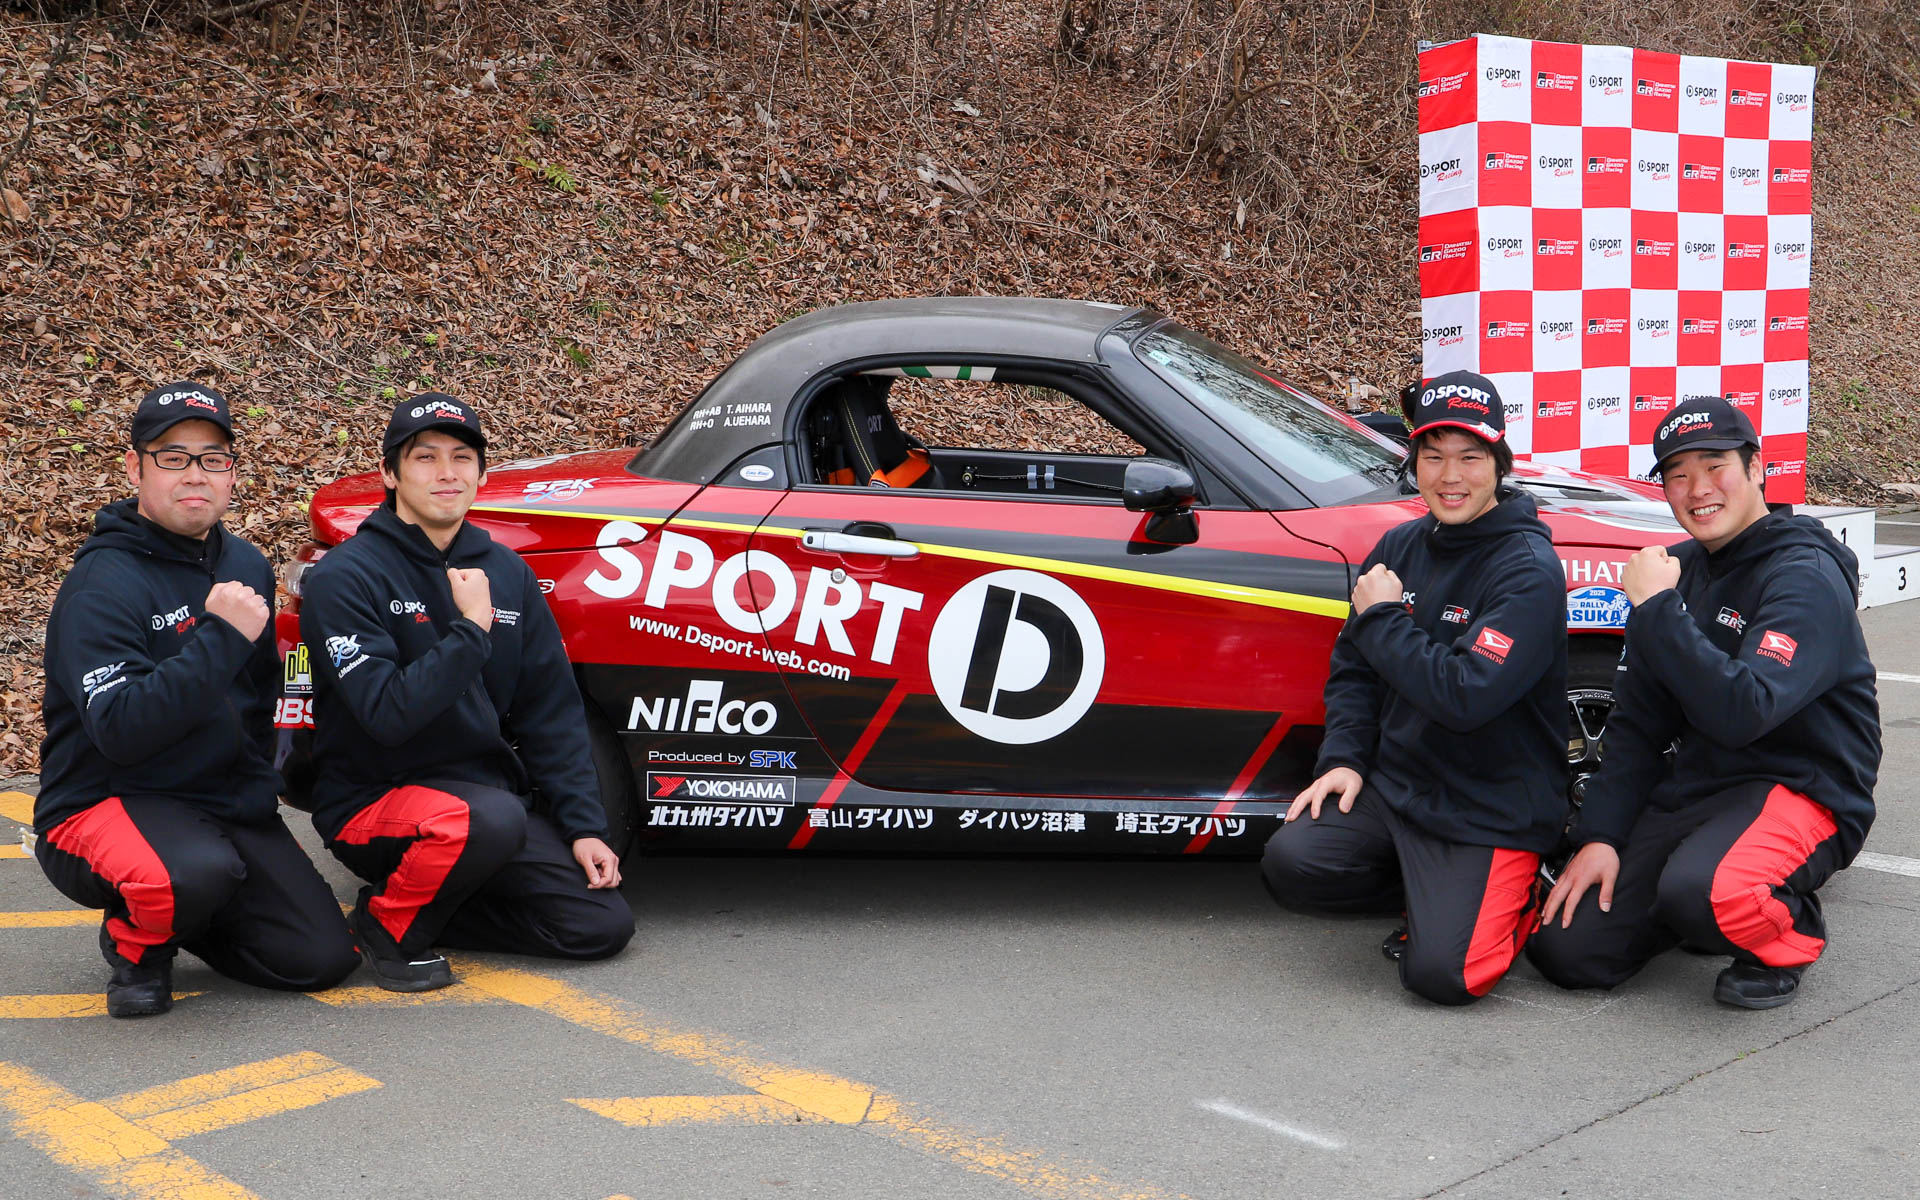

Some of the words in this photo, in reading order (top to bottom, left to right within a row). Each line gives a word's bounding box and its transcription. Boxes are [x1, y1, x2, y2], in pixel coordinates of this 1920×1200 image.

[1537, 79, 1554, 88] GR
[1419, 85, 1438, 96] GR
[1637, 86, 1653, 95] GR
[1730, 96, 1745, 104] GR
[1486, 159, 1503, 169] GR
[1588, 163, 1604, 172] GR
[1684, 170, 1699, 178] GR
[1774, 174, 1788, 182] GR
[1537, 245, 1554, 254] GR
[1636, 246, 1651, 255] GR
[1728, 249, 1743, 257] GR
[1421, 251, 1442, 262] GR
[1588, 325, 1604, 334] GR
[1683, 325, 1698, 333] GR
[1770, 322, 1785, 330] GR
[1488, 328, 1505, 337] GR
[174, 391, 214, 405] SPORT
[1436, 384, 1491, 404] SPORT
[185, 398, 218, 413] Racing
[425, 401, 462, 415] SPORT
[1447, 396, 1490, 415] Racing
[1634, 402, 1650, 411] GR
[435, 409, 467, 423] Racing
[693, 406, 721, 420] RH+AB
[1539, 408, 1554, 417] GR
[1669, 412, 1710, 432] SPORT
[1677, 421, 1714, 436] Racing
[1766, 467, 1782, 476] GR
[522, 478, 601, 493] SPK
[1841, 527, 1847, 545] 1
[1898, 566, 1907, 591] 3
[583, 520, 925, 665] SPORT
[1580, 601, 1605, 609] RALLY
[1442, 611, 1460, 622] GR
[628, 615, 851, 682] www.Dsport-web.com
[1471, 645, 1505, 665] DAIHATSU
[1756, 648, 1791, 668] DAIHATSU
[627, 680, 778, 735] NIFCO
[648, 751, 725, 762] Produced
[728, 752, 746, 765] by
[750, 750, 798, 769] SPK
[685, 779, 786, 799] YOKOHAMA
[647, 805, 784, 827] 北九州ダイハツ
[958, 810, 1086, 833] ダイハツ沼津
[1115, 812, 1246, 837] 埼玉ダイハツ
